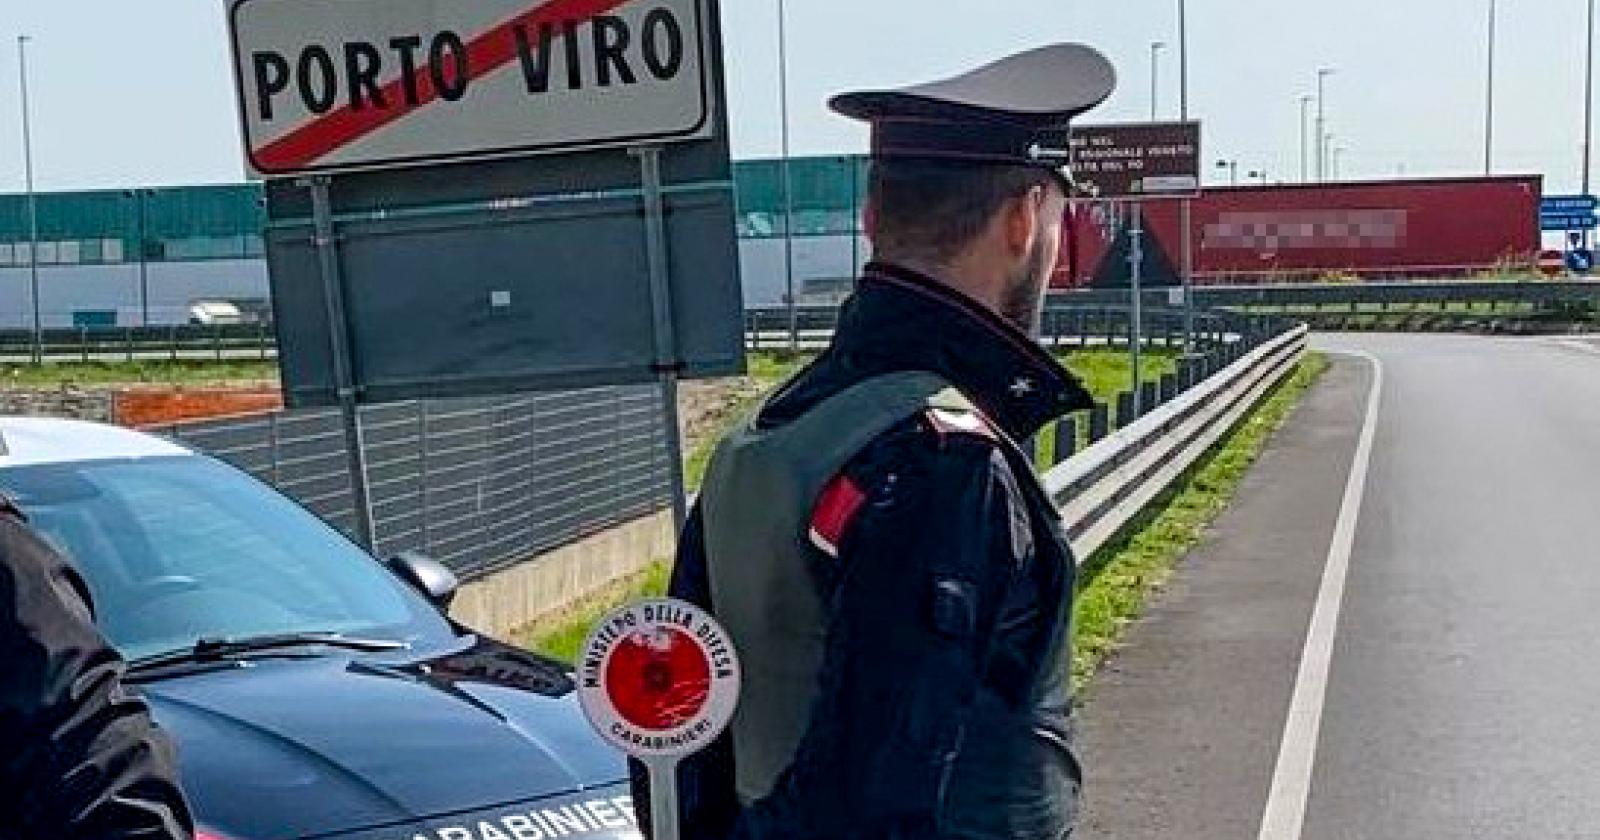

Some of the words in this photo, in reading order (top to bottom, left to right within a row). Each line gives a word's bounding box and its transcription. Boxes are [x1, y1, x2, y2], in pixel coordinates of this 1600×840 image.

[252, 30, 468, 120] PORTO
[514, 7, 683, 93] VIRO
[644, 605, 692, 628] DELLA
[697, 622, 733, 679] DIFESA
[612, 719, 710, 748] CARABINIERI
